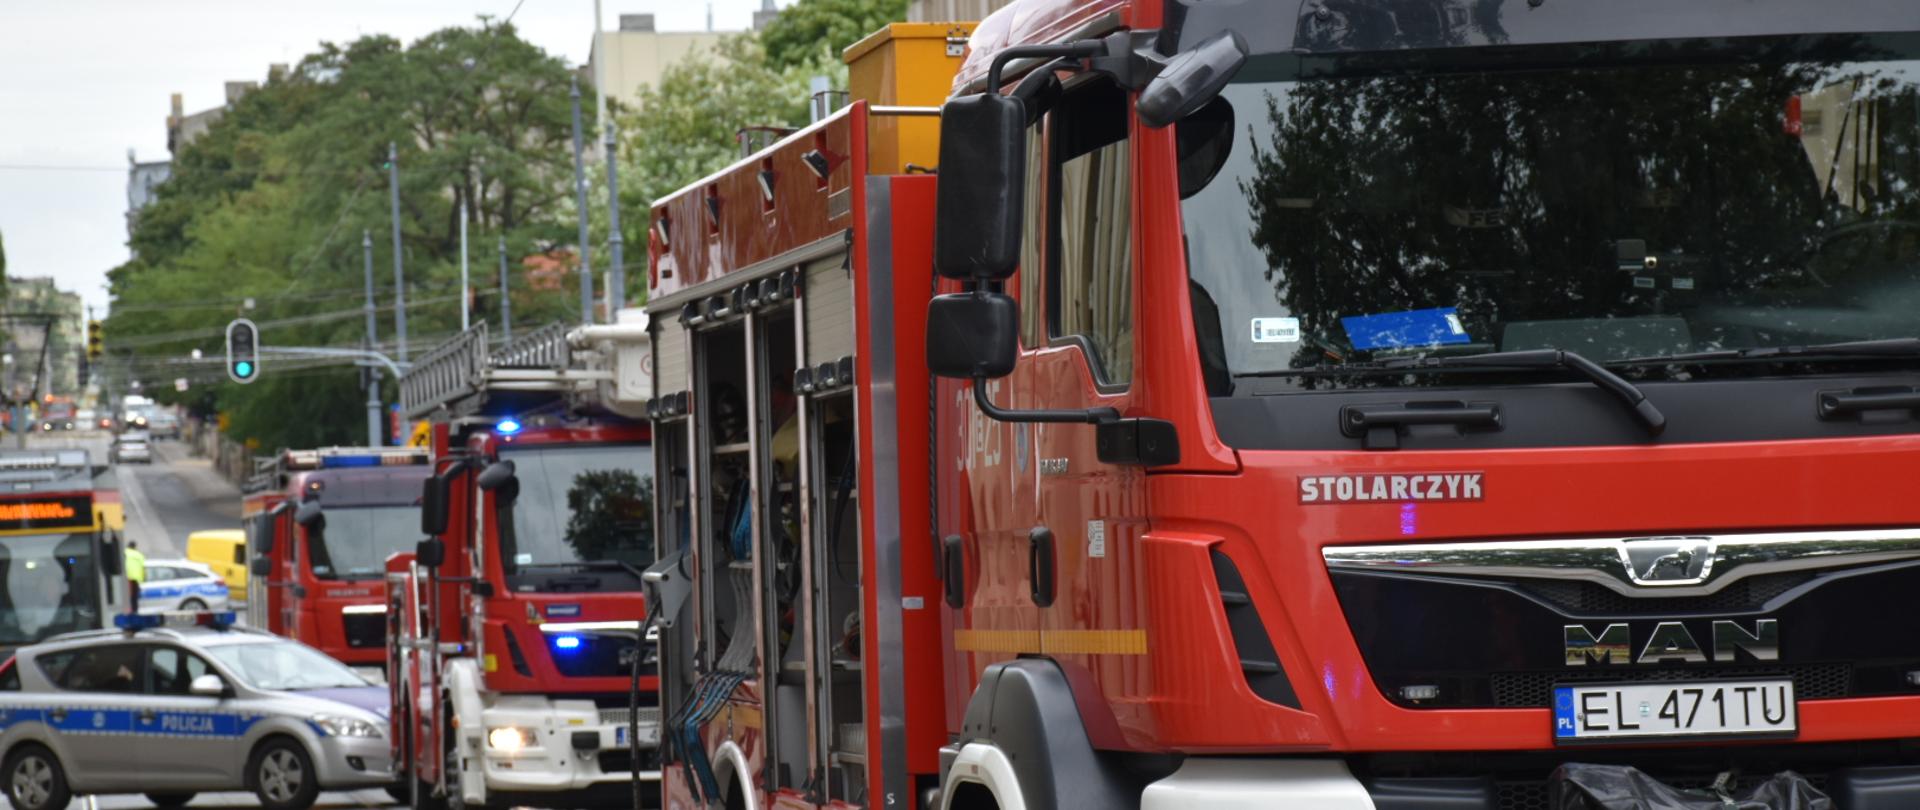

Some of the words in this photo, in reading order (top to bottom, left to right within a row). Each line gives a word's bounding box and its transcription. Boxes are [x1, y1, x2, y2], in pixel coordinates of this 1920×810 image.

[1301, 474, 1482, 502] STOLARCZYK
[1564, 619, 1779, 666] MAN
[161, 713, 216, 733] POLICJA
[1558, 717, 1574, 730] PL
[1581, 690, 1641, 732] EL
[1658, 685, 1786, 729] 471TU
